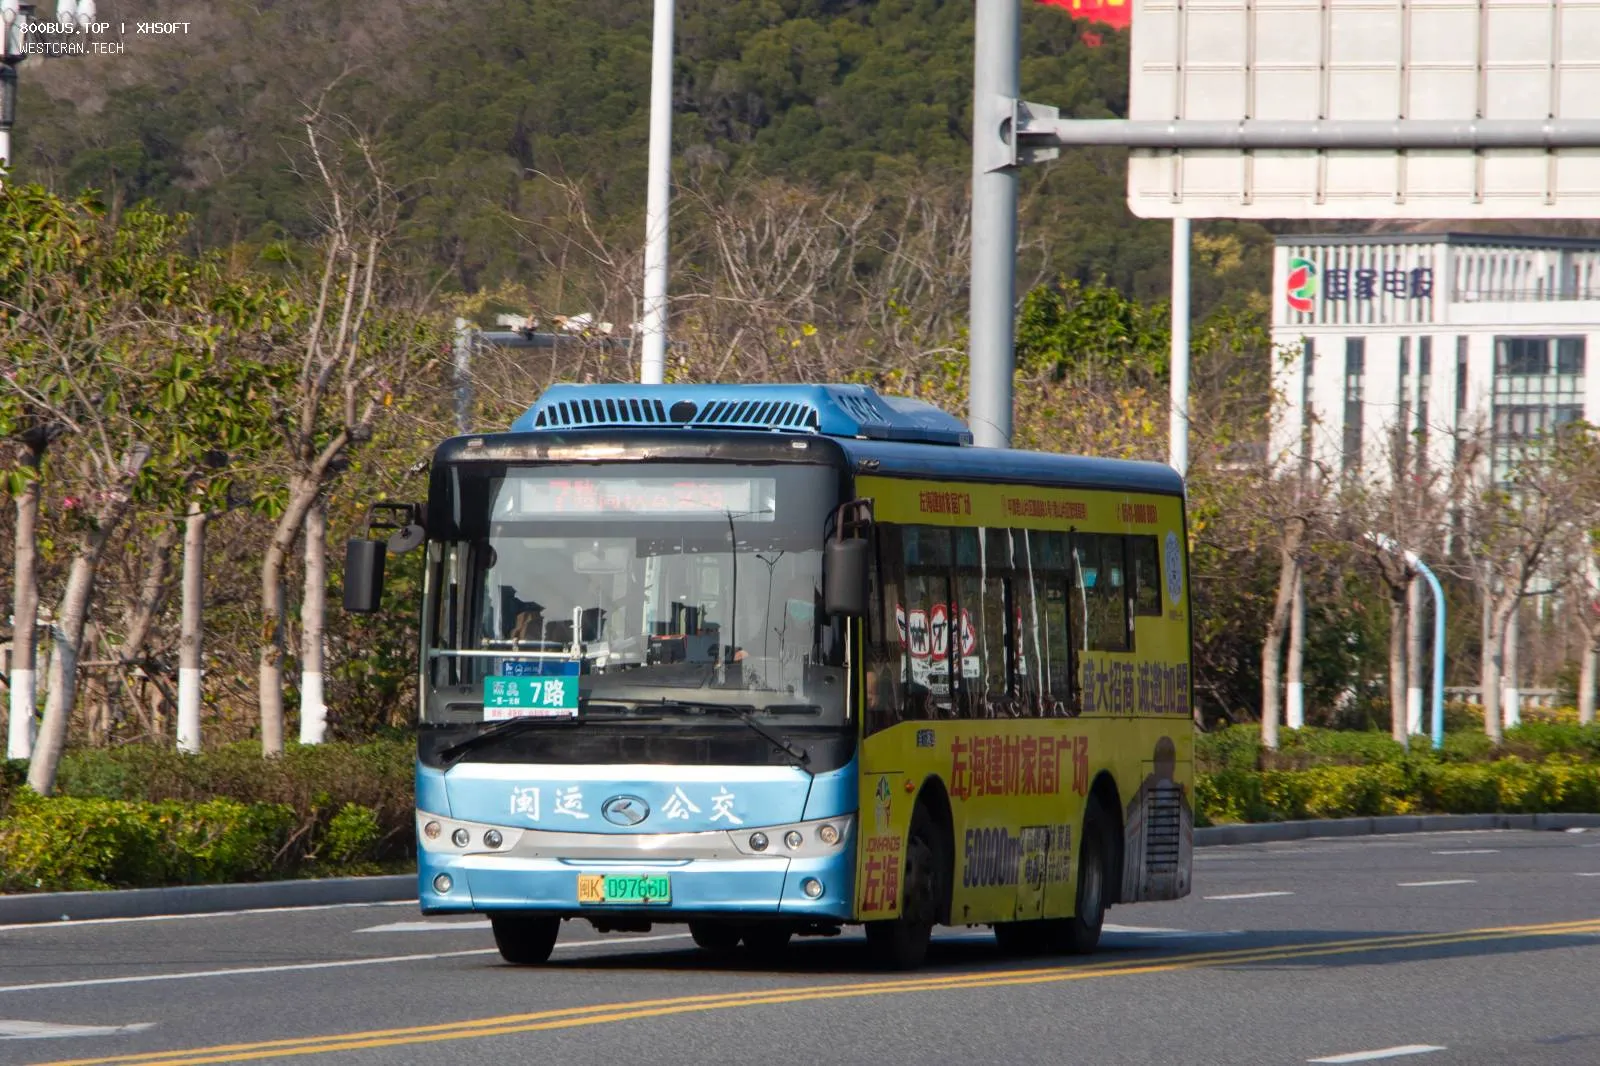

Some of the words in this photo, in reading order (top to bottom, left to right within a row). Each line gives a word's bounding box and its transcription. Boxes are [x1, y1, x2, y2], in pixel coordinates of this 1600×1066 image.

[1325, 268, 1433, 300] 国家电投
[950, 734, 1089, 797] 左海建材家居广场
[510, 786, 590, 822] 闽运
[661, 786, 744, 825] 公交
[862, 854, 899, 912] 左海
